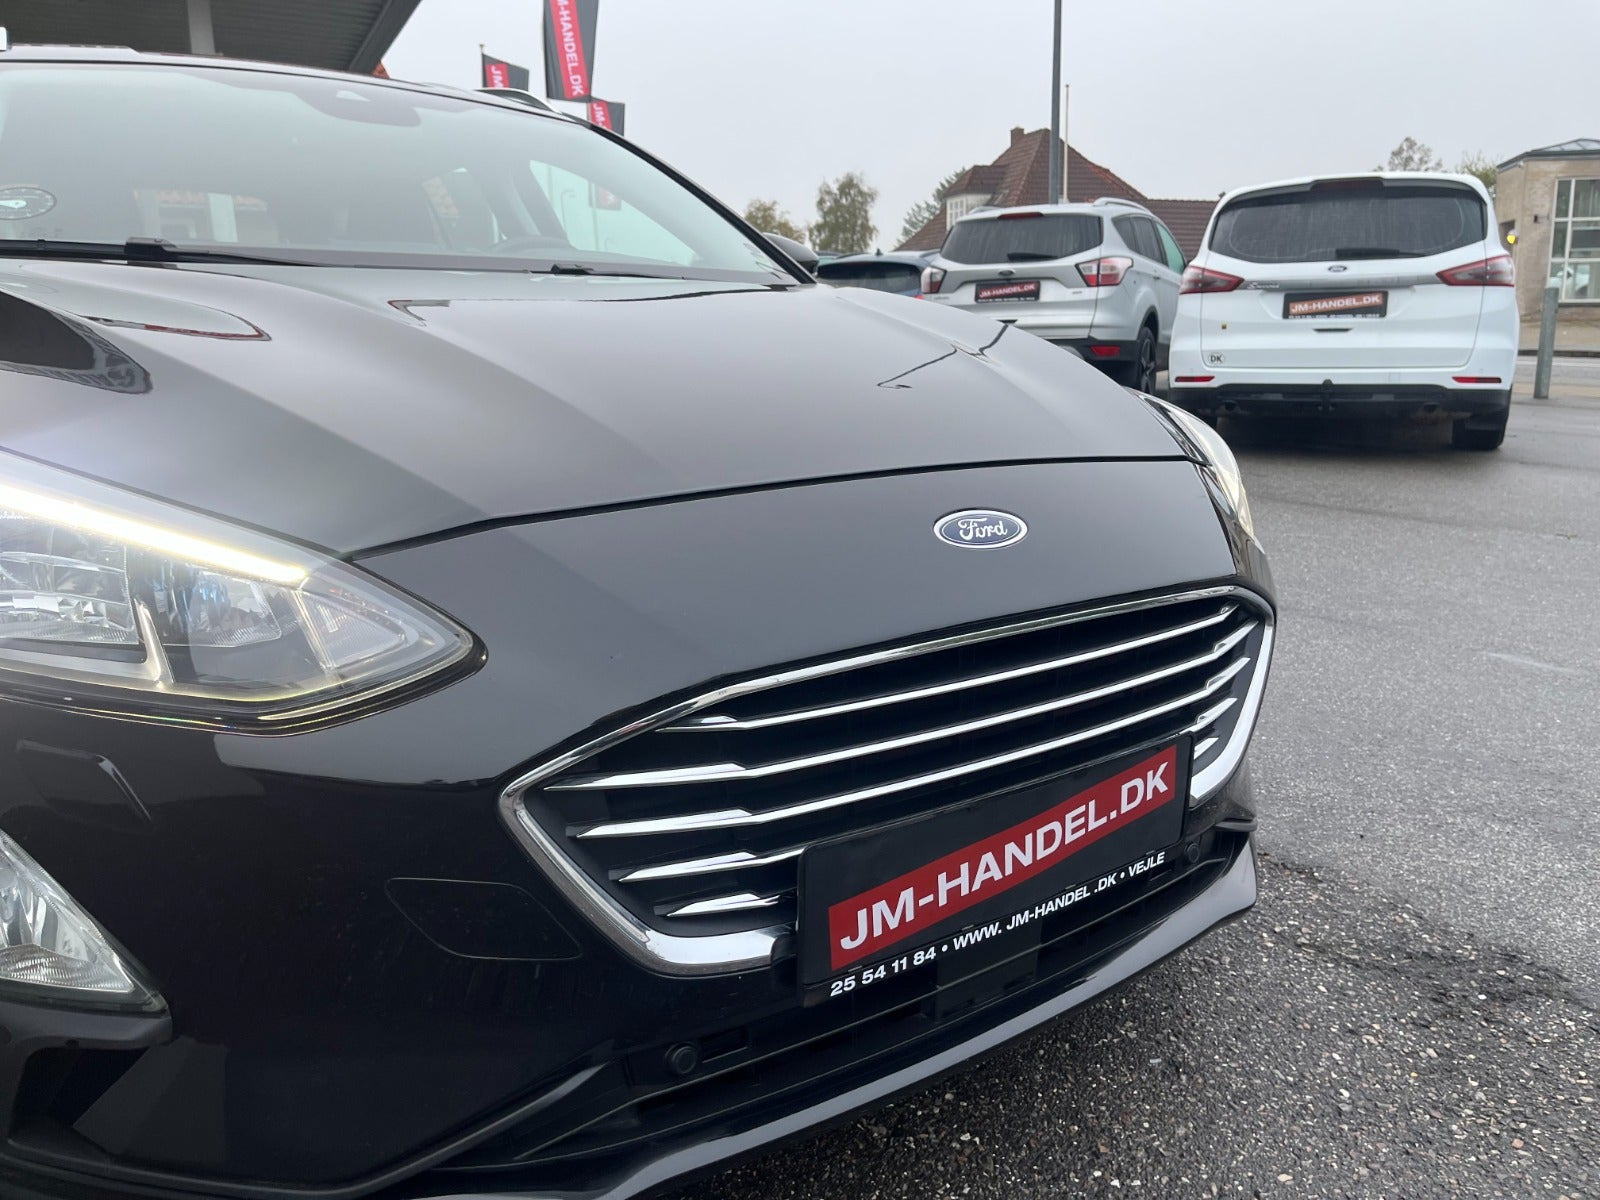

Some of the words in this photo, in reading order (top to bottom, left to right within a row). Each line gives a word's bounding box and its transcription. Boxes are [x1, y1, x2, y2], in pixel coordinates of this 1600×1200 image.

[980, 284, 1035, 298] JM-HANDEL.DK
[1291, 295, 1380, 312] JM-HANDEL.DK
[1210, 354, 1223, 363] DK
[958, 518, 1008, 540] Ford
[840, 761, 1169, 950] JM-HANDEL.DK
[830, 976, 856, 997] 25
[861, 965, 886, 984] 54
[892, 957, 908, 973] 11
[913, 946, 937, 965] 84
[953, 922, 1001, 950] WWW.
[1128, 851, 1166, 877] VEJLE
